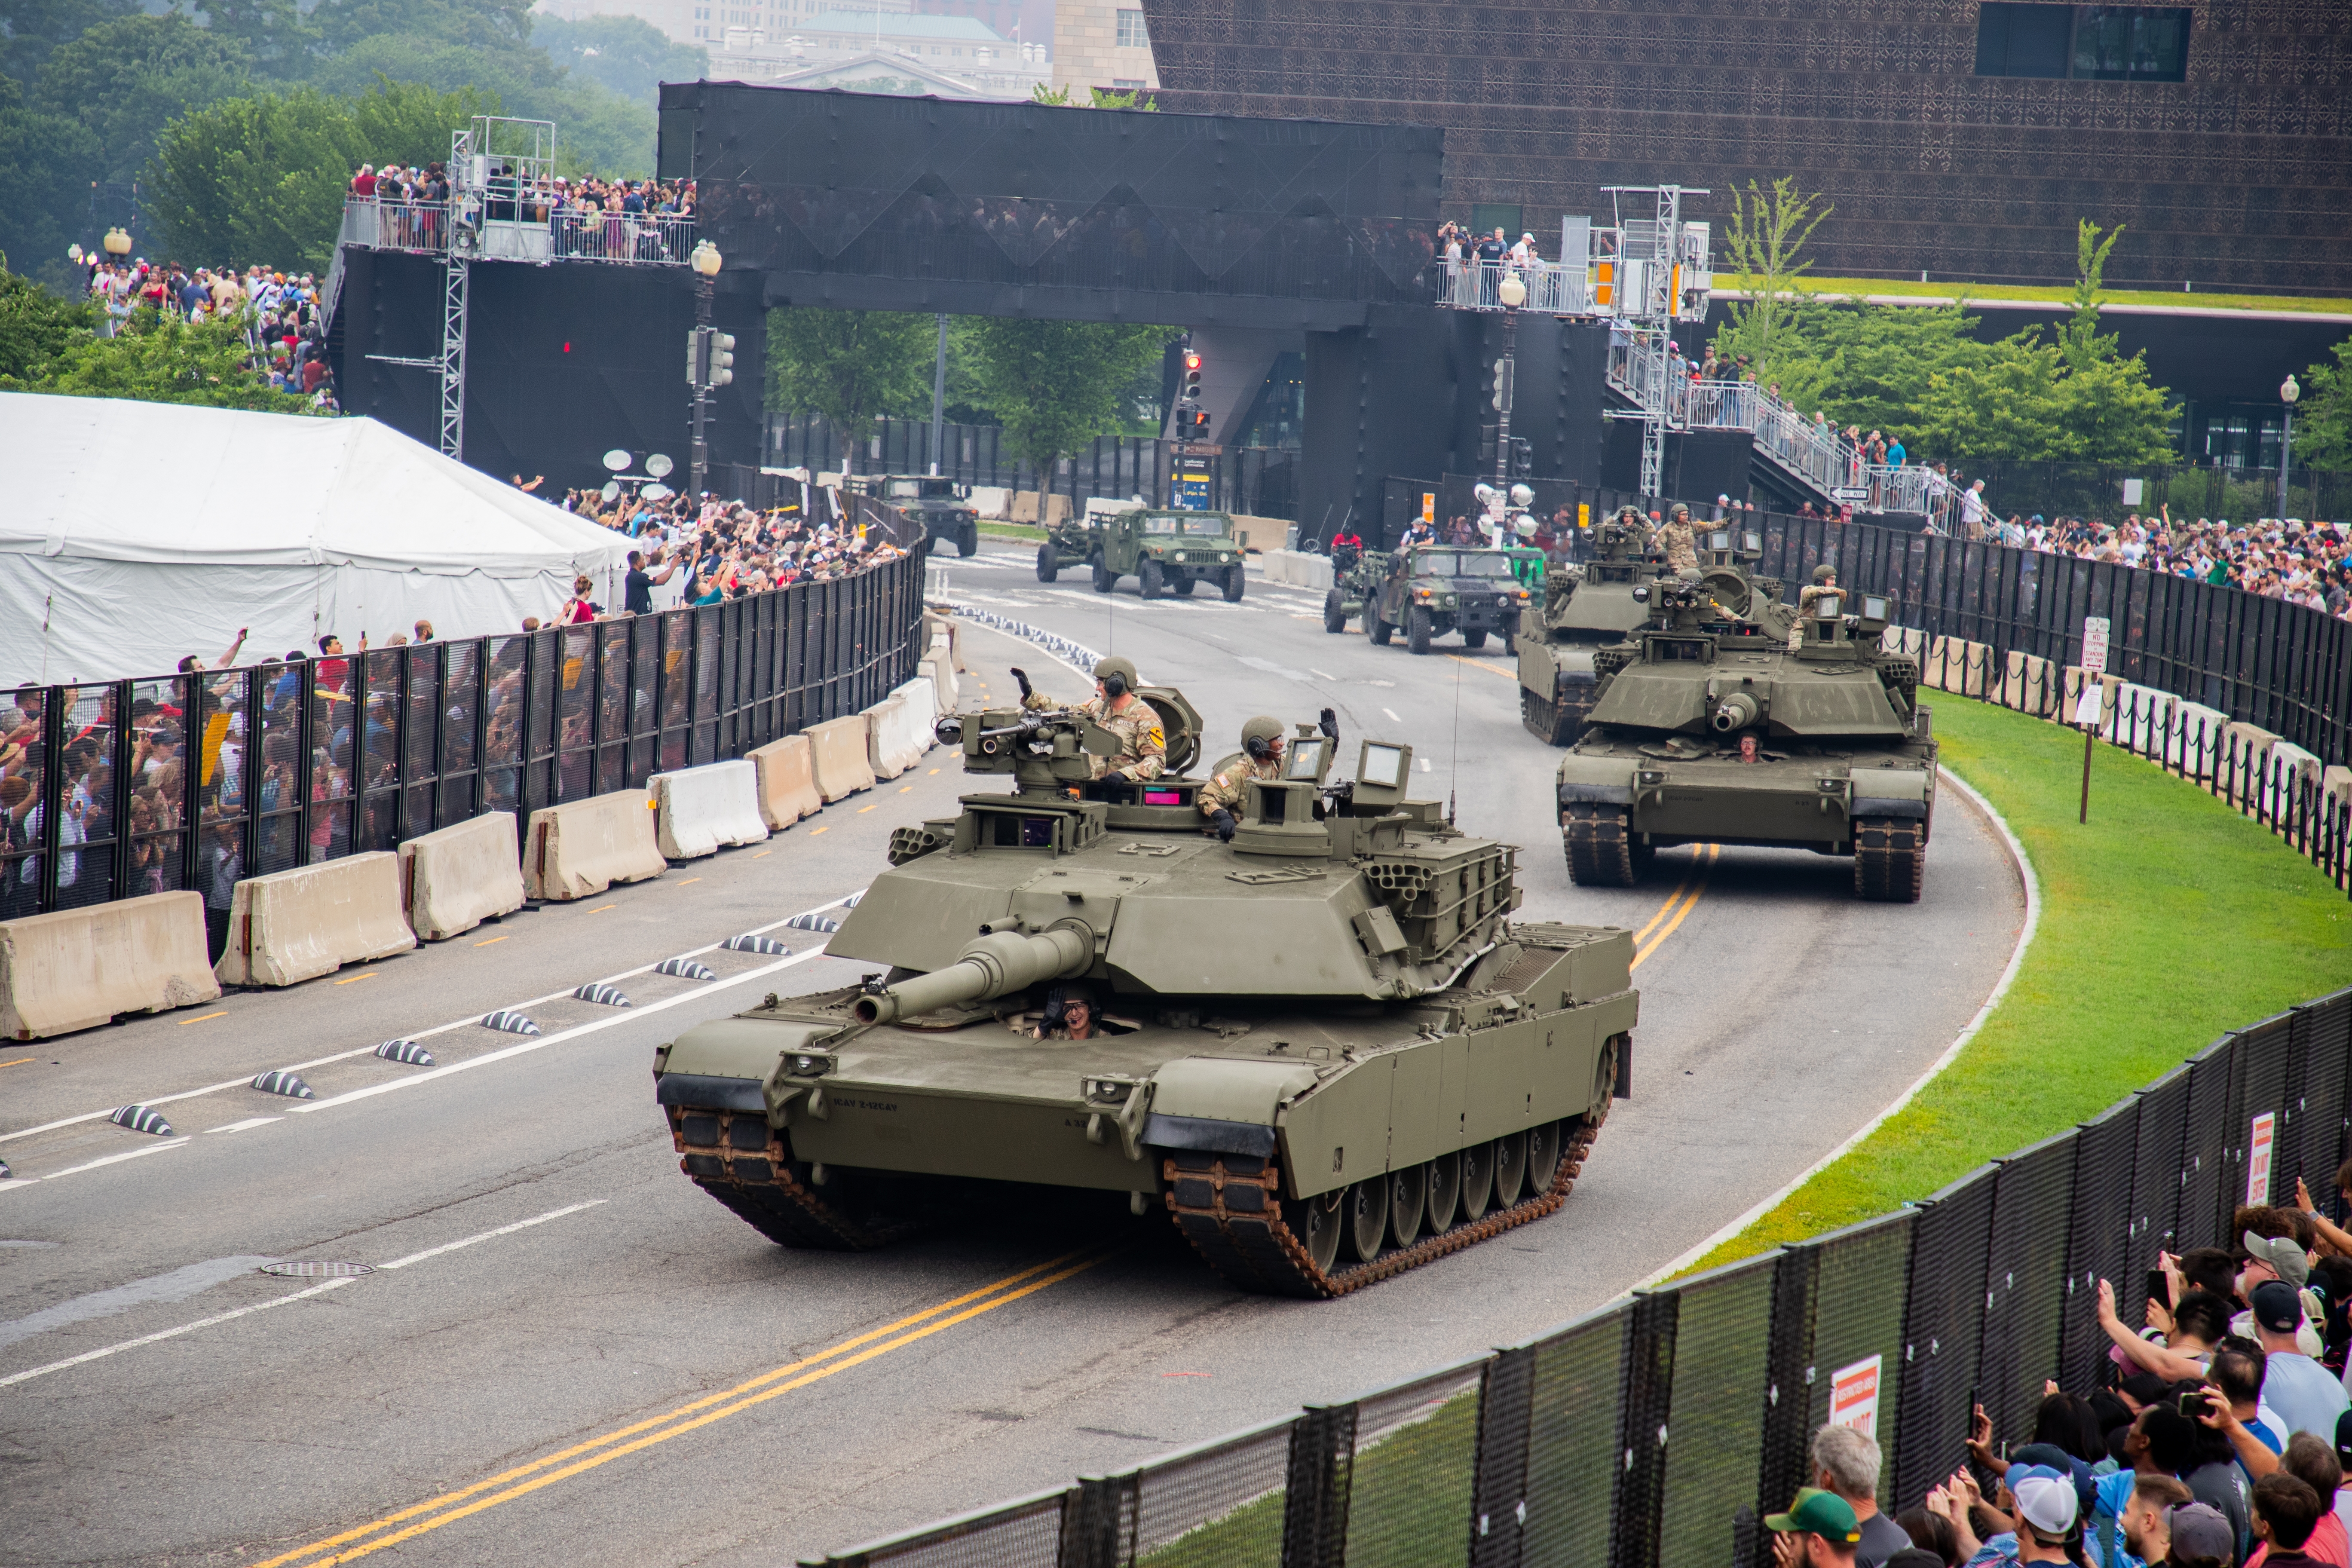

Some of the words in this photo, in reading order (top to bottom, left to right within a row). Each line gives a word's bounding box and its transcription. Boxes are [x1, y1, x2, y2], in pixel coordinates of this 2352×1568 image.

[833, 1098, 855, 1107] 1CAV
[859, 1100, 897, 1112] 2-12CAV
[1074, 1119, 1087, 1128] 32
[1837, 1381, 1863, 1403] RESTRICTED
